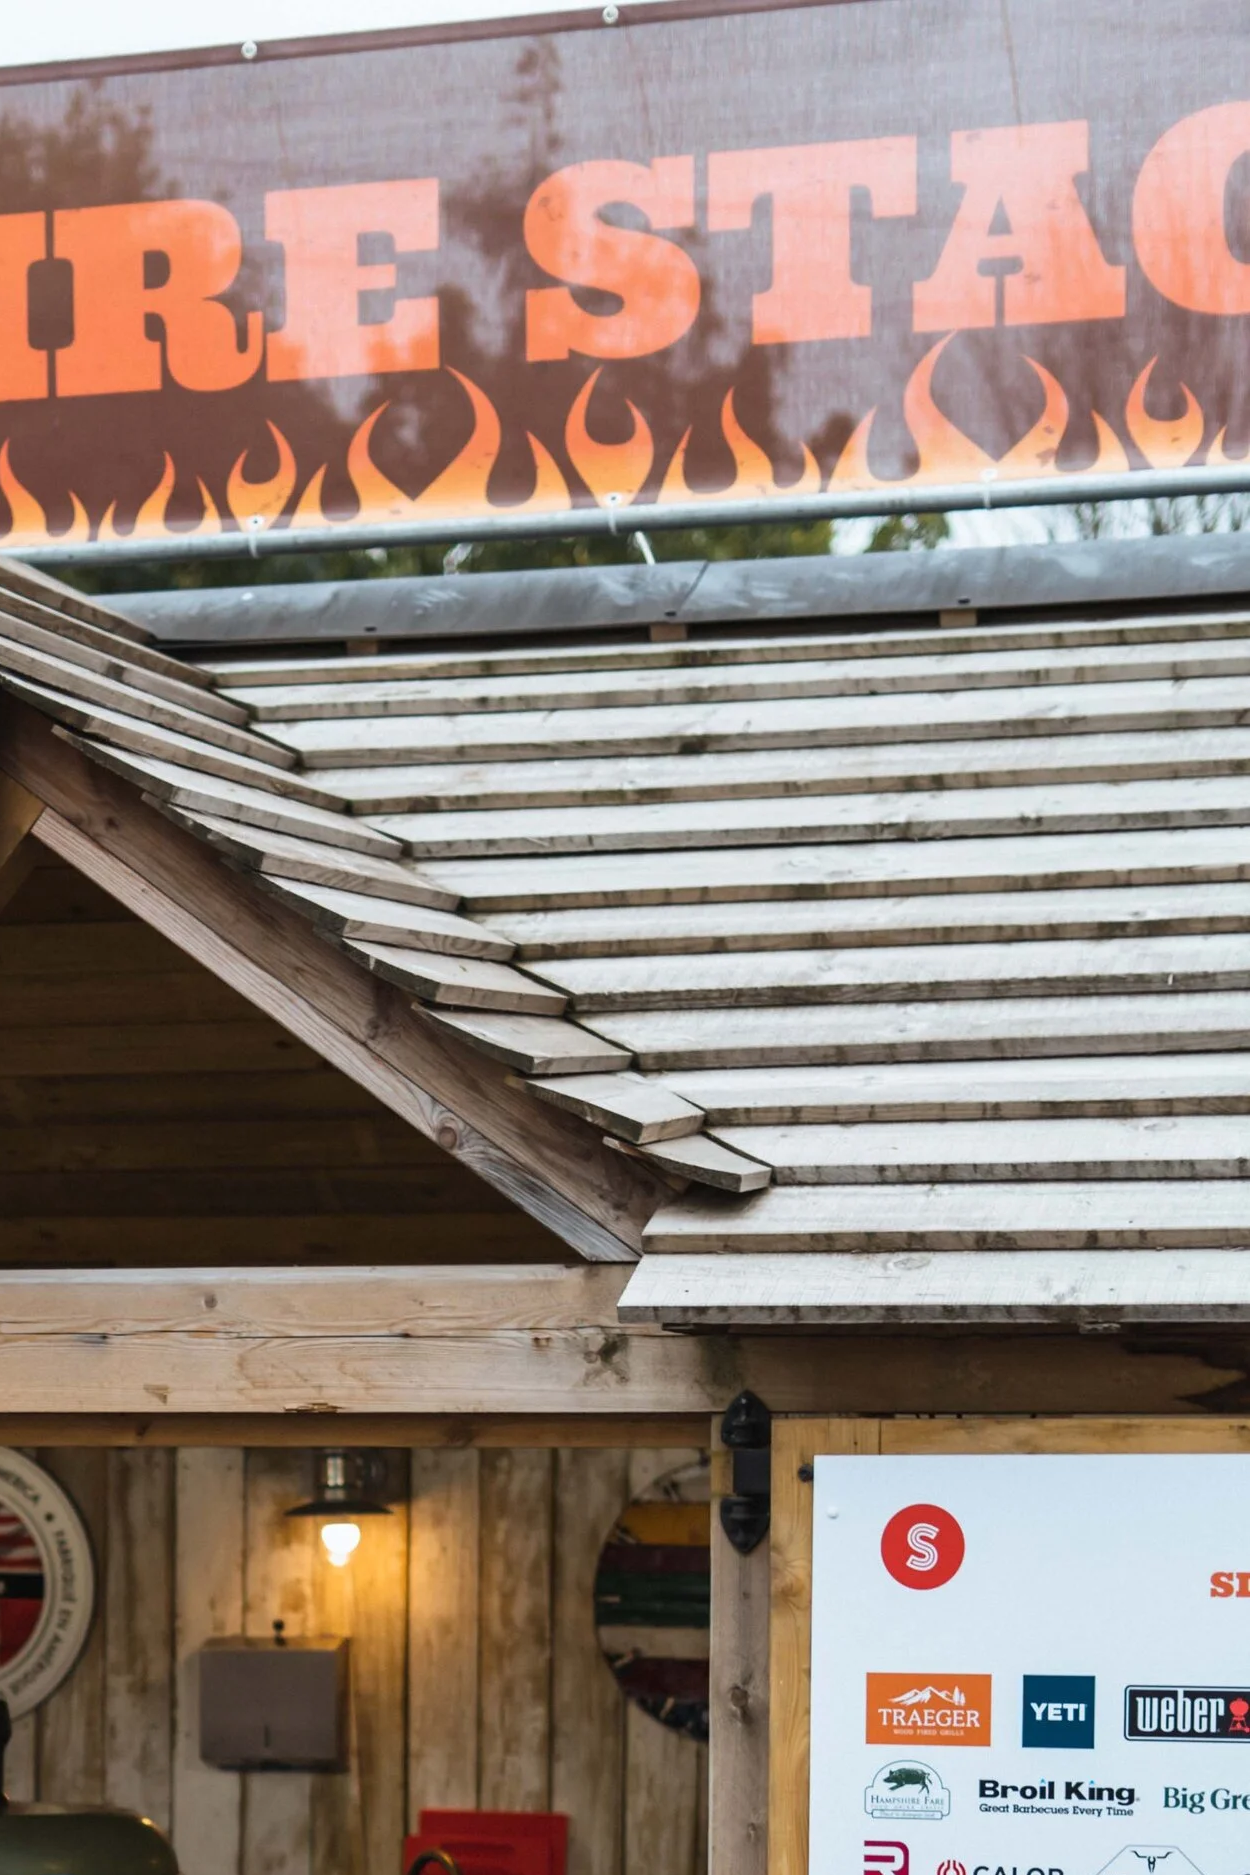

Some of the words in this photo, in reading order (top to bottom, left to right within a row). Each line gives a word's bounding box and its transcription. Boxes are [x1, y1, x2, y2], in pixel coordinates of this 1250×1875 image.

[878, 1708, 980, 1728] TRAEGER
[1030, 1702, 1086, 1721] YETI
[1135, 1691, 1225, 1733] weber
[979, 1778, 1055, 1800] Broil
[1065, 1780, 1136, 1806] King
[1163, 1786, 1205, 1814] Big
[979, 1803, 1009, 1813] Great
[1013, 1804, 1069, 1815] Barbecues
[1072, 1806, 1102, 1817] Every
[1106, 1807, 1134, 1816] Time
